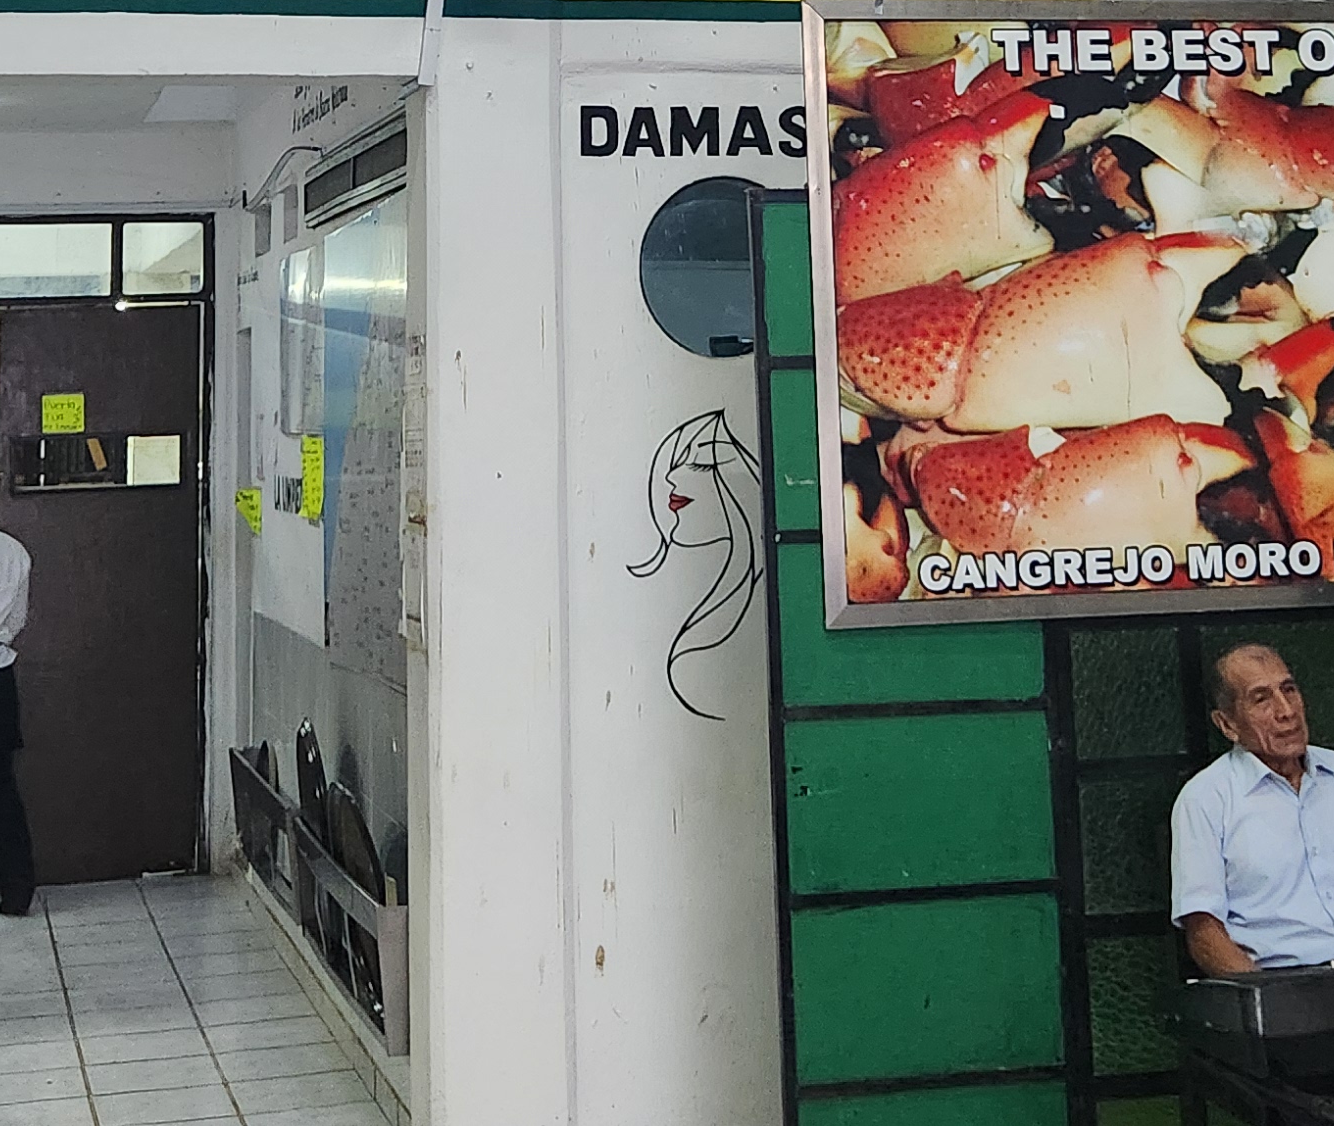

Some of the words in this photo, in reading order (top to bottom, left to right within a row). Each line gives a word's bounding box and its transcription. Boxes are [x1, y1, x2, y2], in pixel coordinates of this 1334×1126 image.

[992, 28, 1112, 74] THE
[1131, 29, 1279, 74] BEST
[579, 105, 806, 158] DAMAS
[918, 547, 1173, 592] CANGREJO
[1188, 541, 1320, 580] MORO
